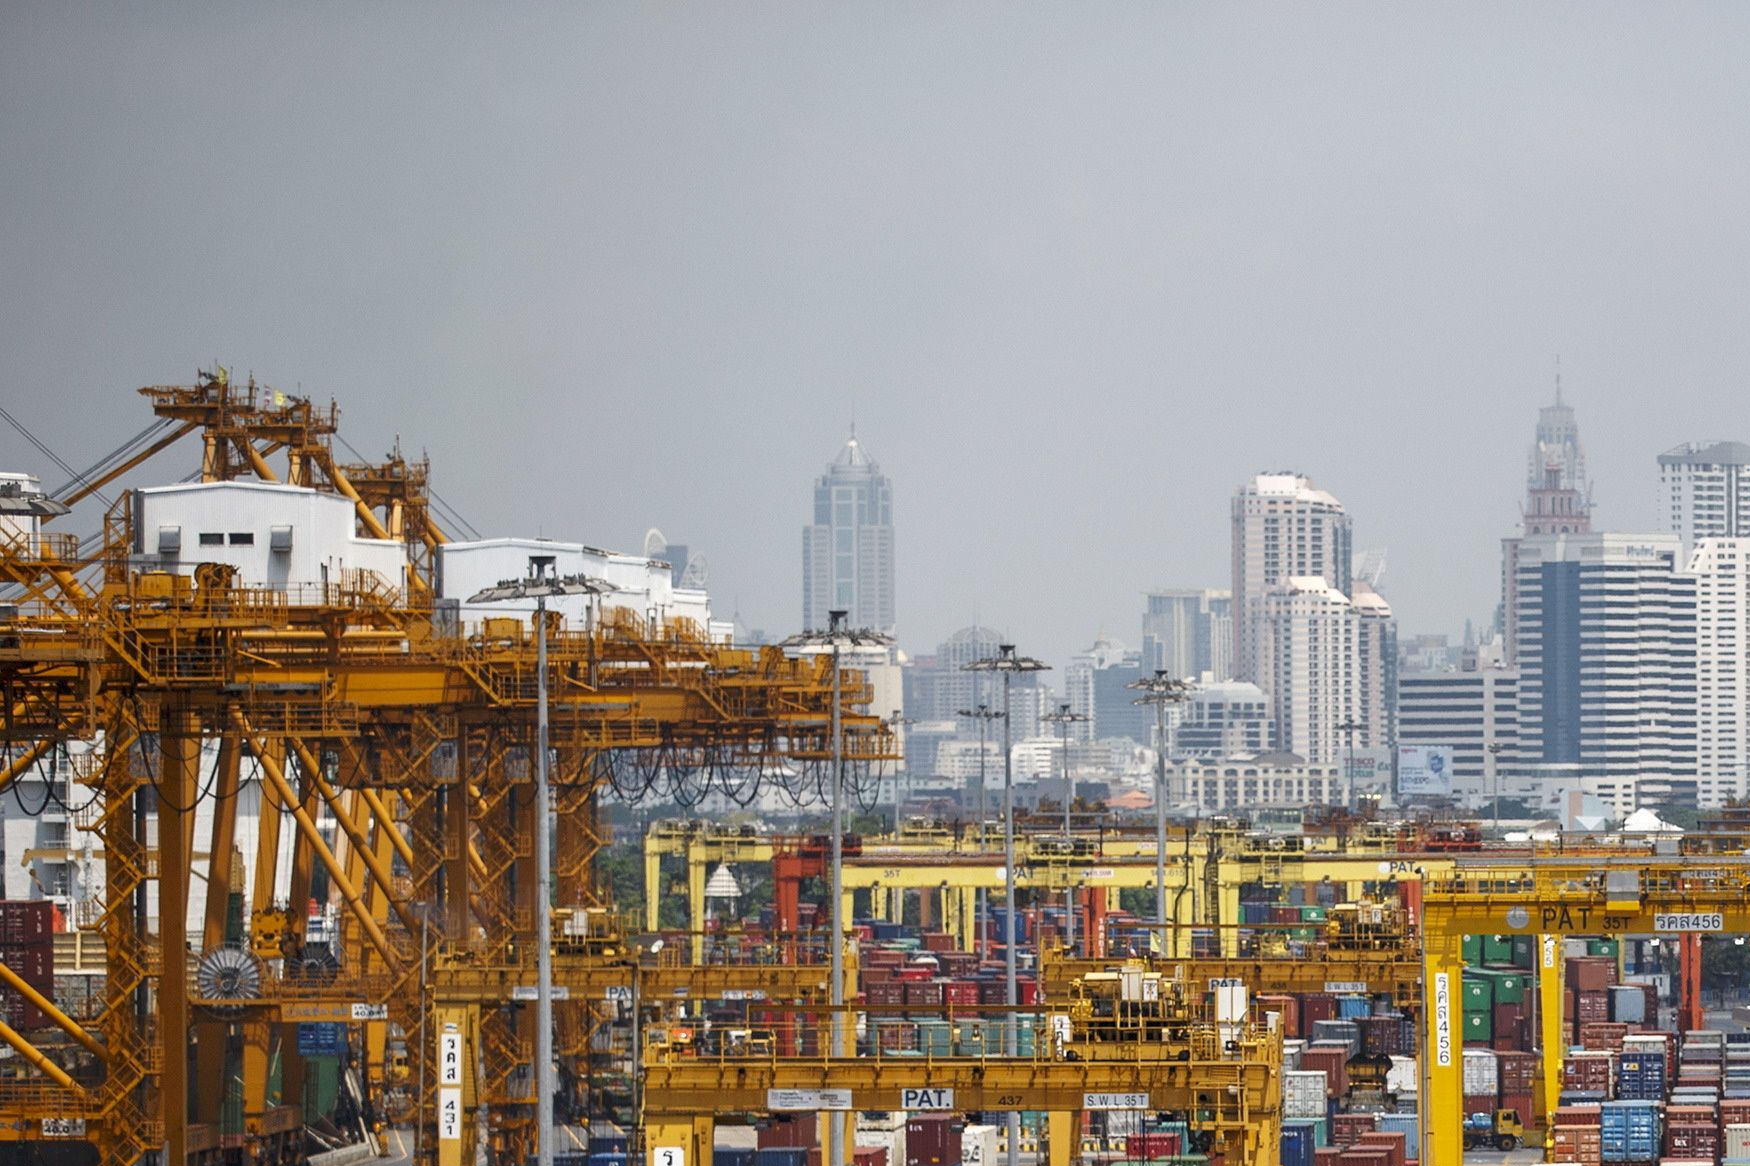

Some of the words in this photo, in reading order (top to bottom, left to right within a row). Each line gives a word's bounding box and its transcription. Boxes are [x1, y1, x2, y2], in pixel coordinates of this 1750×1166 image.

[1389, 861, 1415, 873] PAT
[1542, 907, 1591, 930] PAT
[1602, 916, 1632, 930] 35T
[1655, 913, 1722, 932] รคส456
[904, 1089, 951, 1108] PAT.
[998, 1095, 1023, 1106] 437
[445, 1100, 456, 1135] 431
